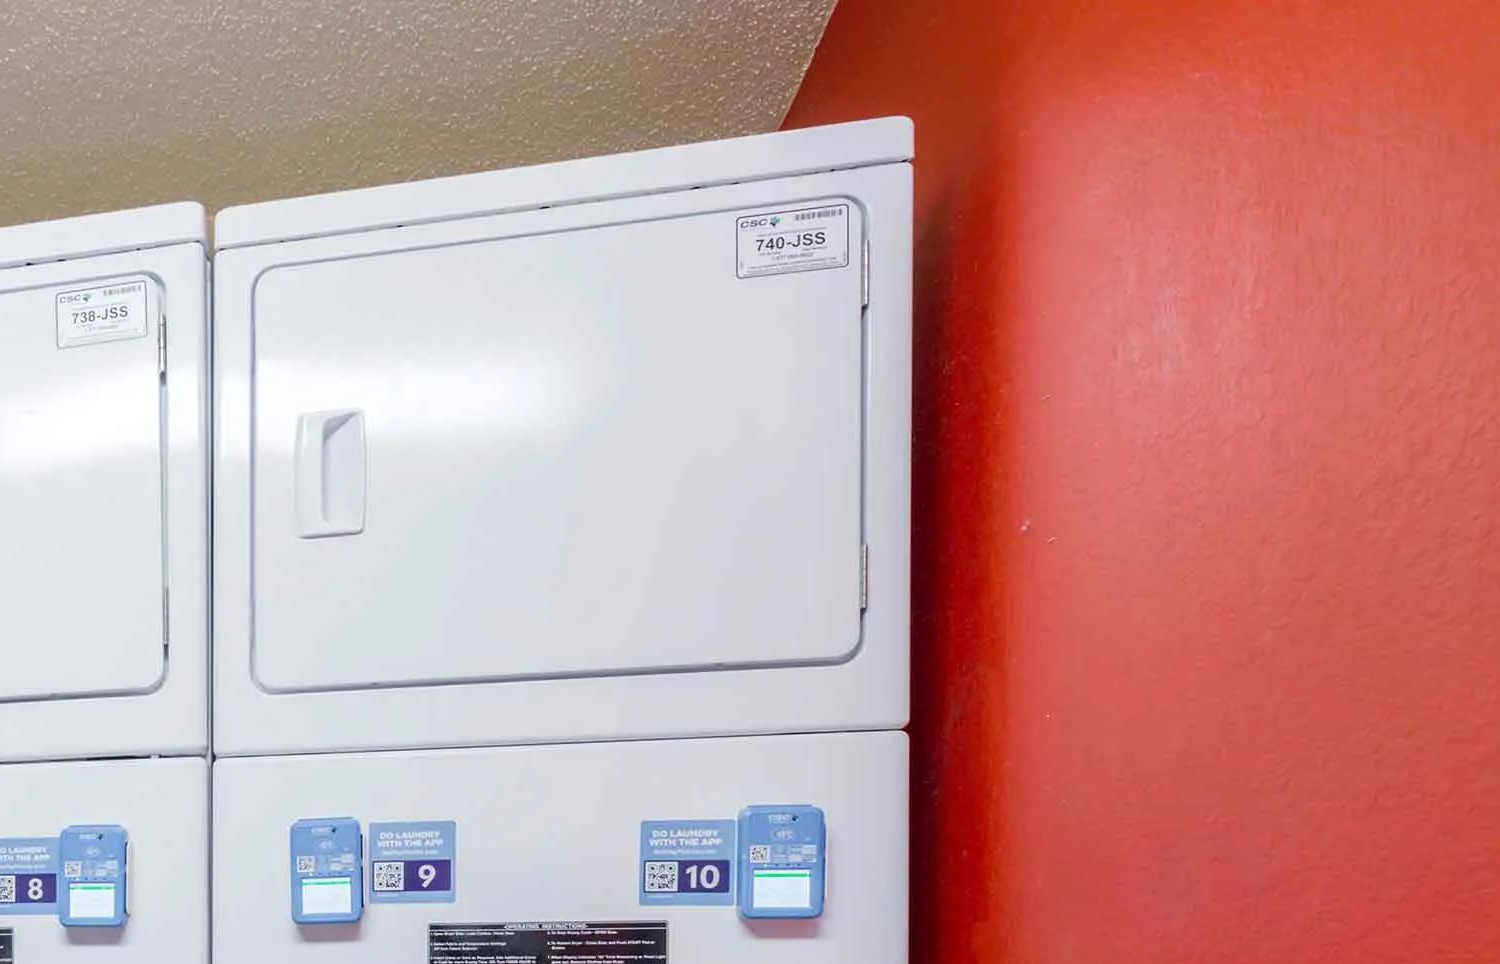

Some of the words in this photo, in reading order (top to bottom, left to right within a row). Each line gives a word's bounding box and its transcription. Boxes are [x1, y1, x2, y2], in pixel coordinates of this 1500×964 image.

[740, 218, 768, 229] CSC
[755, 231, 826, 252] 740-JSS
[72, 305, 129, 324] 738-JSS
[418, 864, 436, 888] 9
[686, 865, 720, 889] 10
[28, 878, 43, 900] 8
